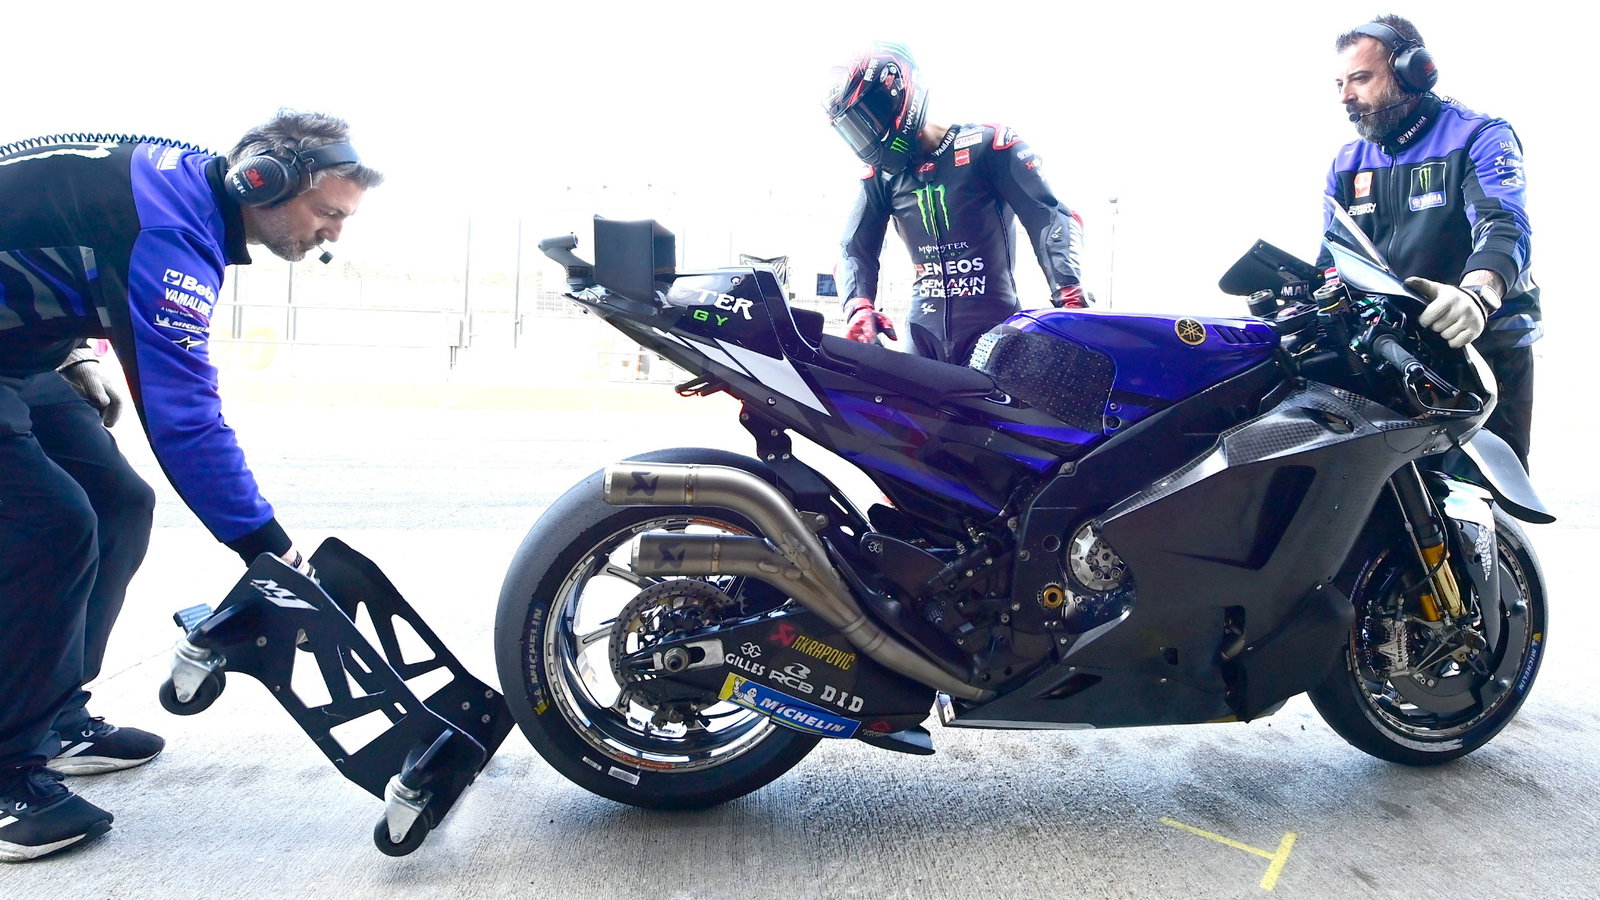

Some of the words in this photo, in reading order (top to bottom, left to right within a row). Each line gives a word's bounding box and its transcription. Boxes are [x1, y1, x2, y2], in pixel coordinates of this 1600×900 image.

[1403, 115, 1427, 139] YAMAHA
[934, 130, 956, 156] YAMAHA
[245, 168, 265, 188] 3M
[918, 241, 969, 255] MONSTER
[923, 257, 984, 276] ENEOS
[165, 287, 213, 318] YAMALUBE
[181, 274, 217, 306] Beta
[172, 321, 209, 334] MICHELI
[528, 607, 543, 684] MICHELIN
[725, 653, 766, 676] GILLES
[1519, 648, 1537, 691] MICHELIN
[768, 669, 814, 694] RCB
[759, 697, 846, 733] MICHELIN
